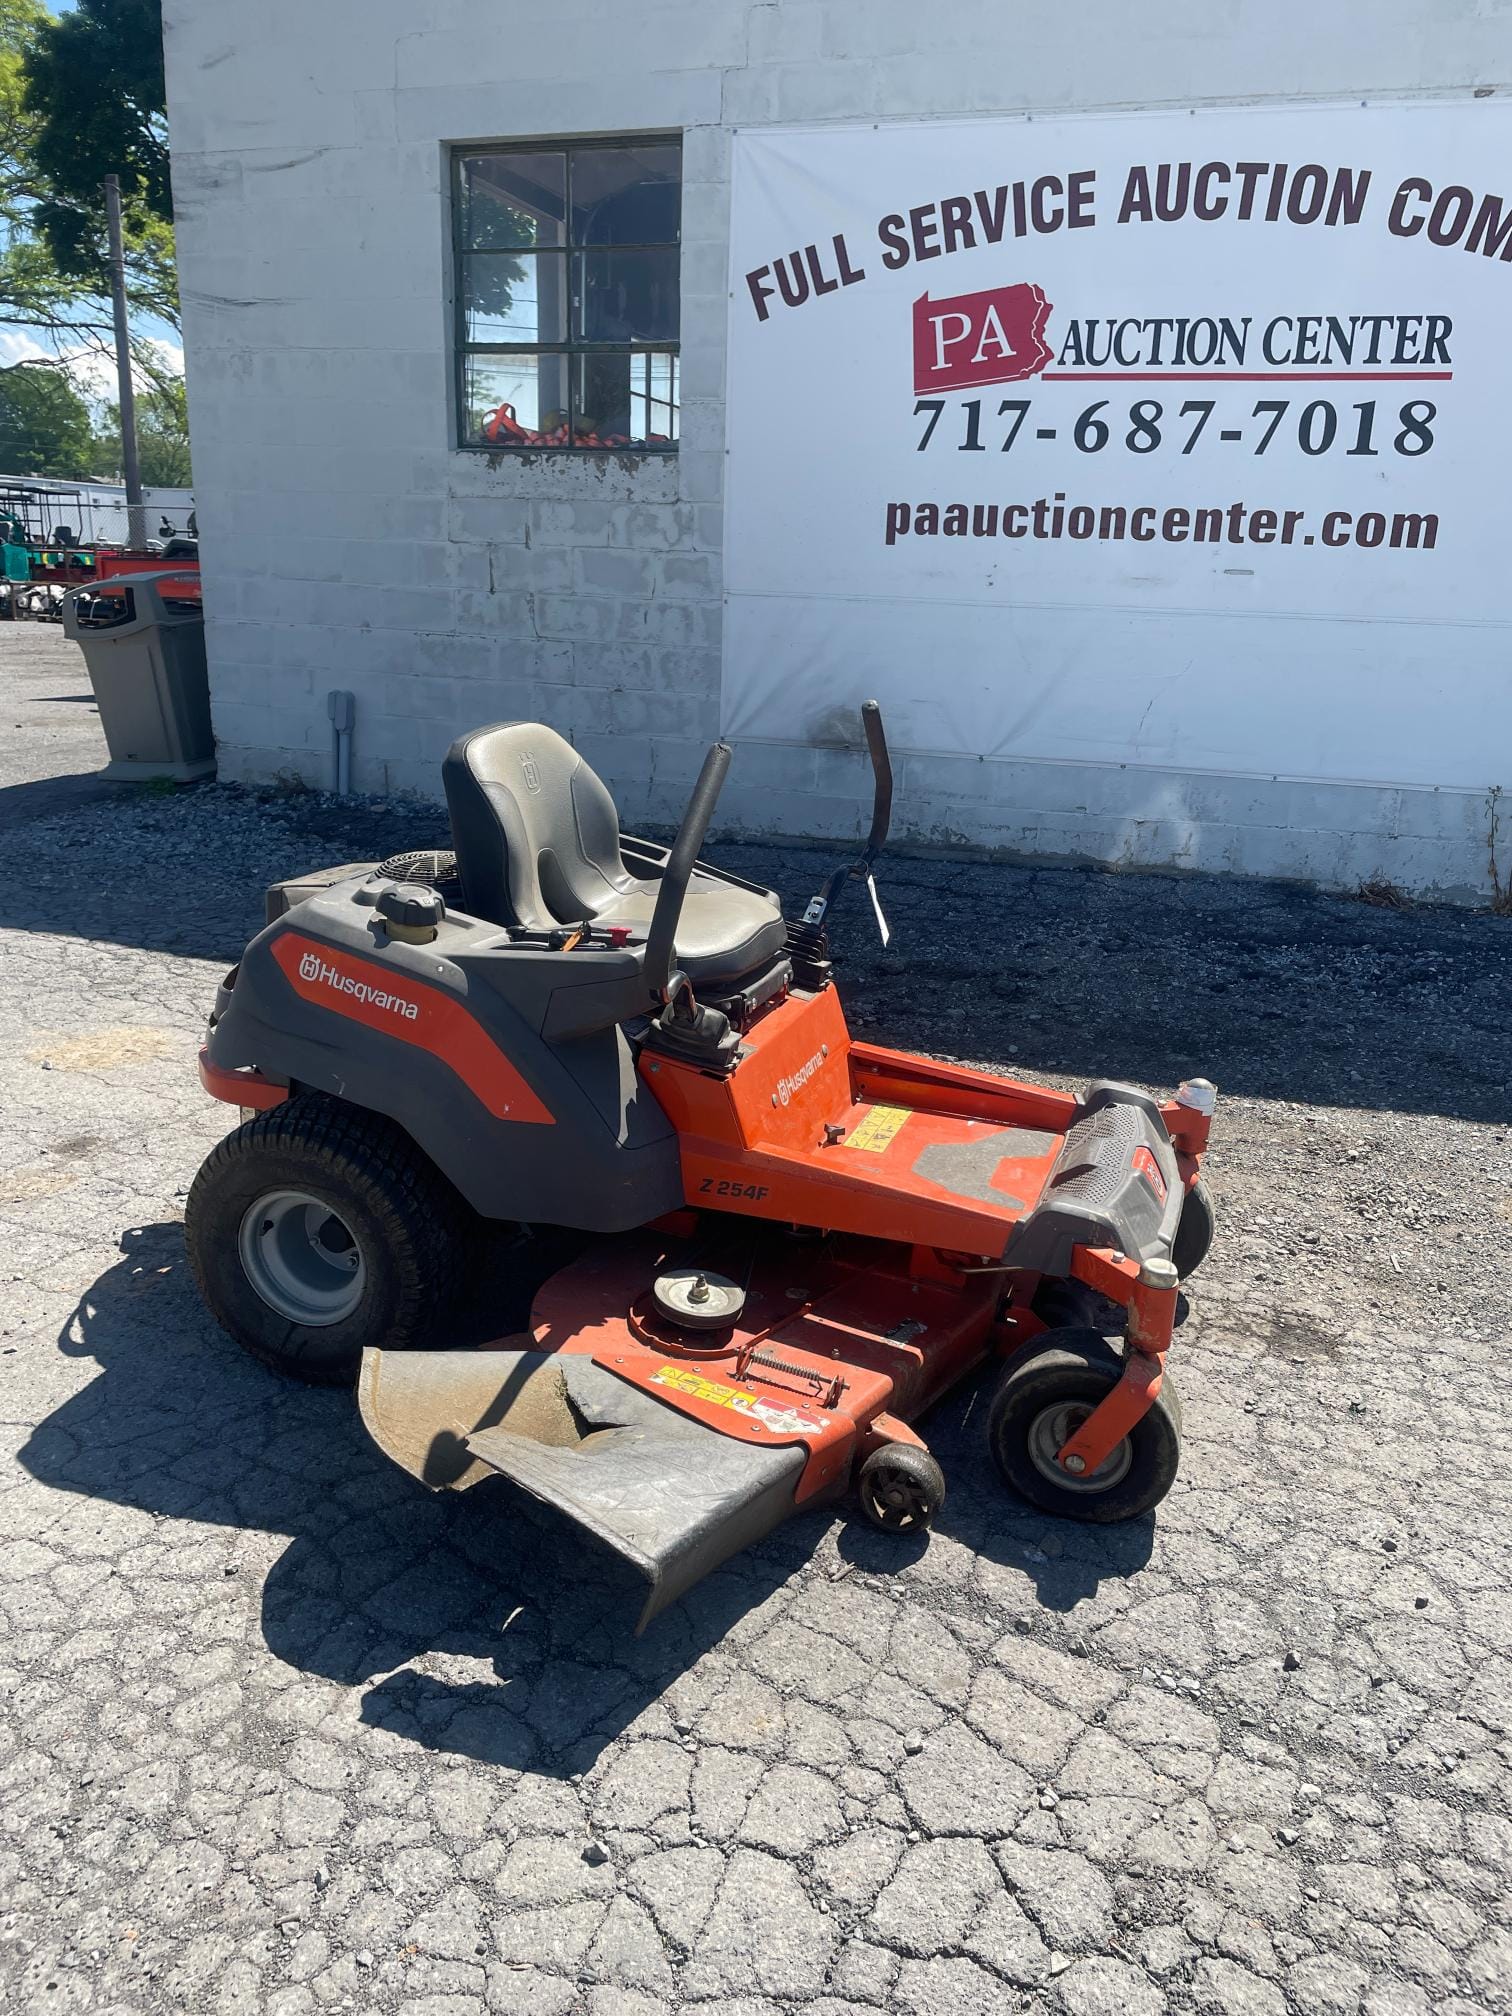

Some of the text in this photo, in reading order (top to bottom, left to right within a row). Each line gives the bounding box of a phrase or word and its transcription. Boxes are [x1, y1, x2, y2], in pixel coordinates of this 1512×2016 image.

[745, 233, 866, 323] FULL
[877, 169, 1097, 270] SERVICE
[1116, 161, 1373, 227] AUCTION
[928, 304, 1454, 370] PA AUCTION CENTER
[912, 399, 1438, 457] 717-687-7018
[884, 492, 1439, 550] paauctioncenter.com
[318, 963, 419, 1020] Husqvarna
[699, 1177, 769, 1201] Z 254F
